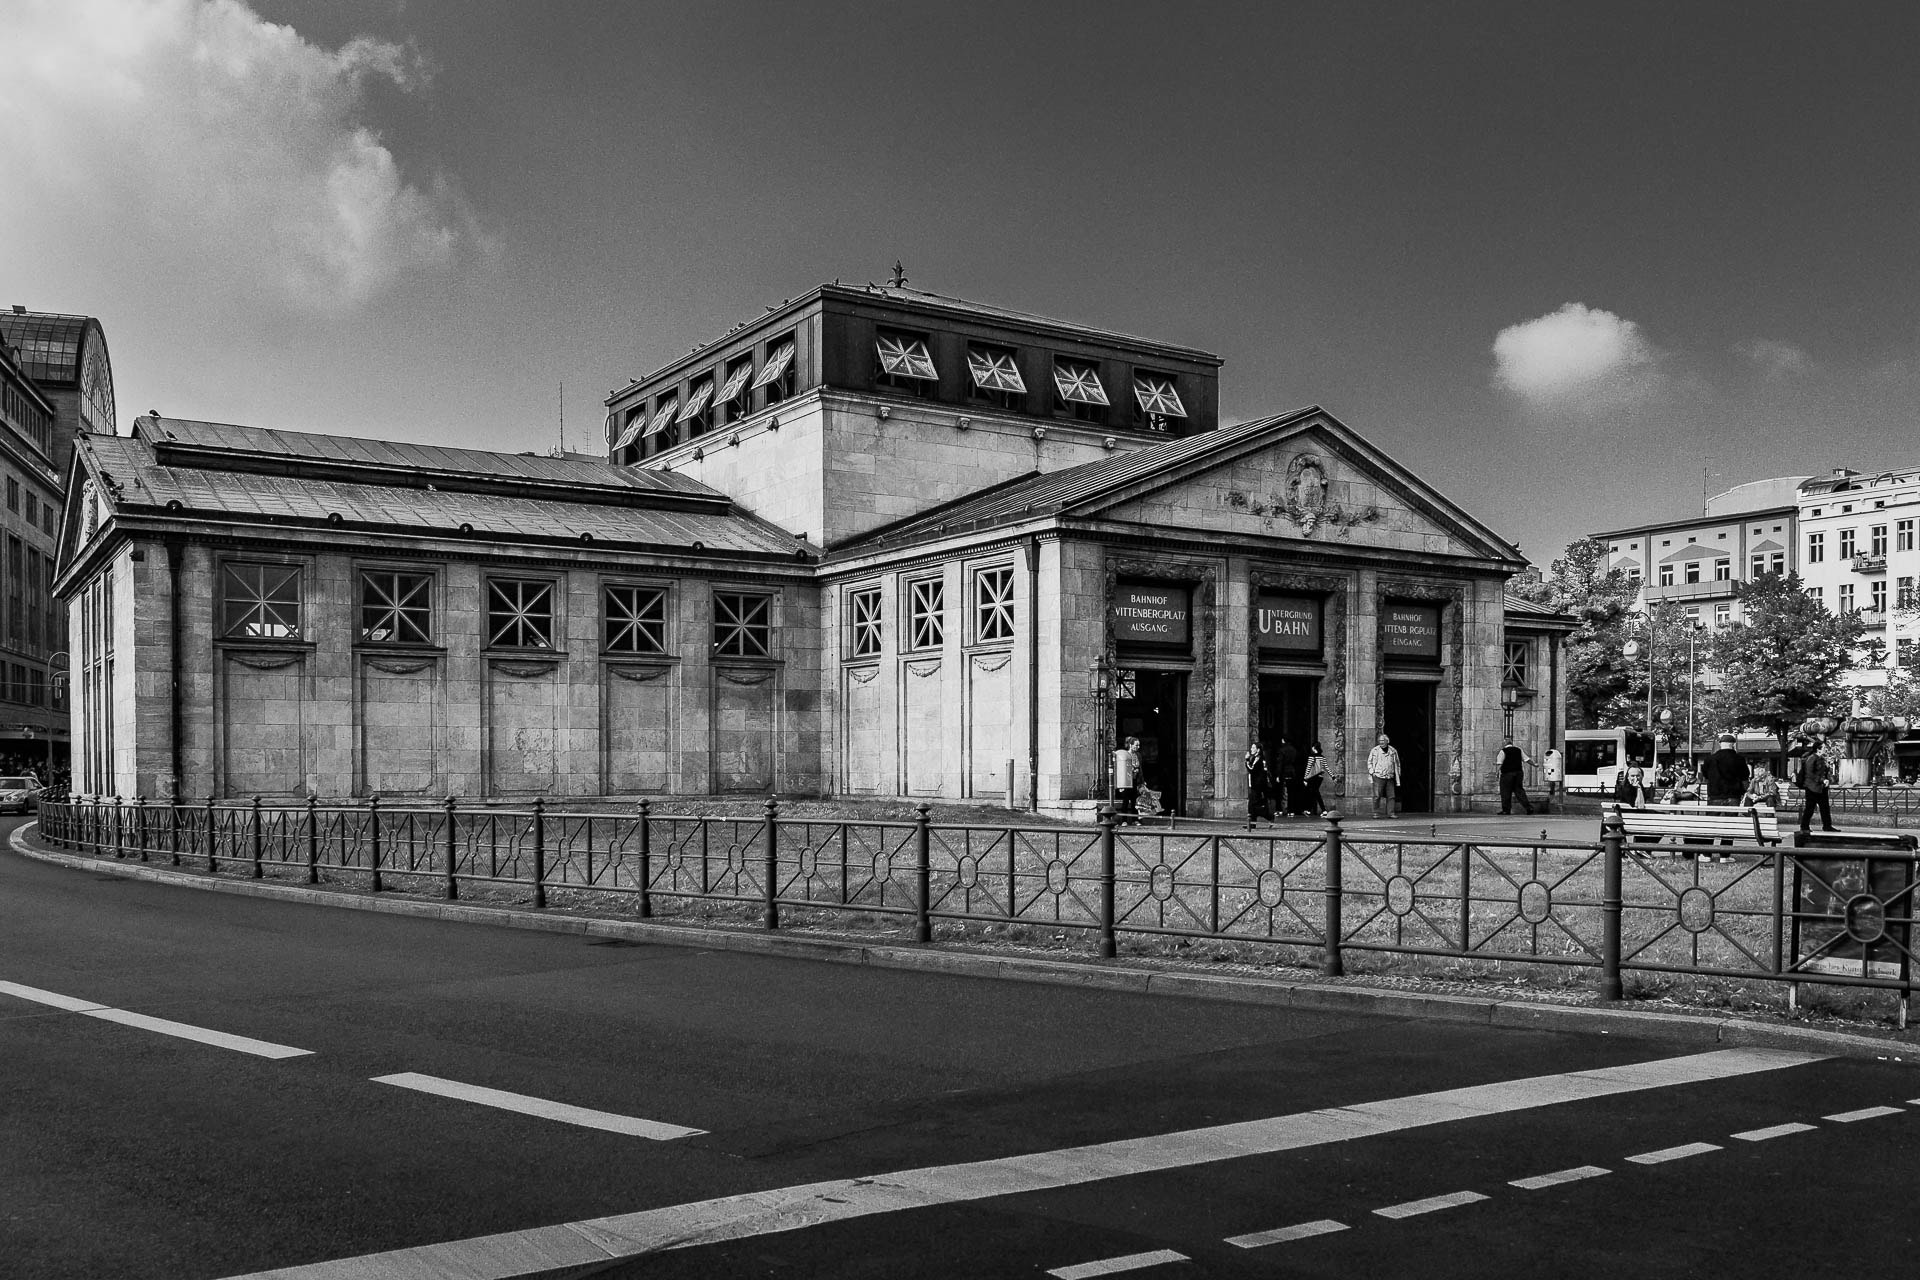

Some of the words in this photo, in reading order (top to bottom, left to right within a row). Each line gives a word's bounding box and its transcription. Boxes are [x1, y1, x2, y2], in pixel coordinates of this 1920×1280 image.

[1131, 594, 1168, 605] BAHNHOF
[1258, 608, 1313, 634] UNTERGRUND
[1392, 612, 1423, 622] BAHNHOF
[1130, 622, 1168, 633] AUSGANG
[1275, 620, 1310, 636] BAHN
[1384, 624, 1437, 636] ITTENBRGPLATZ
[1392, 637, 1422, 647] EINGANG
